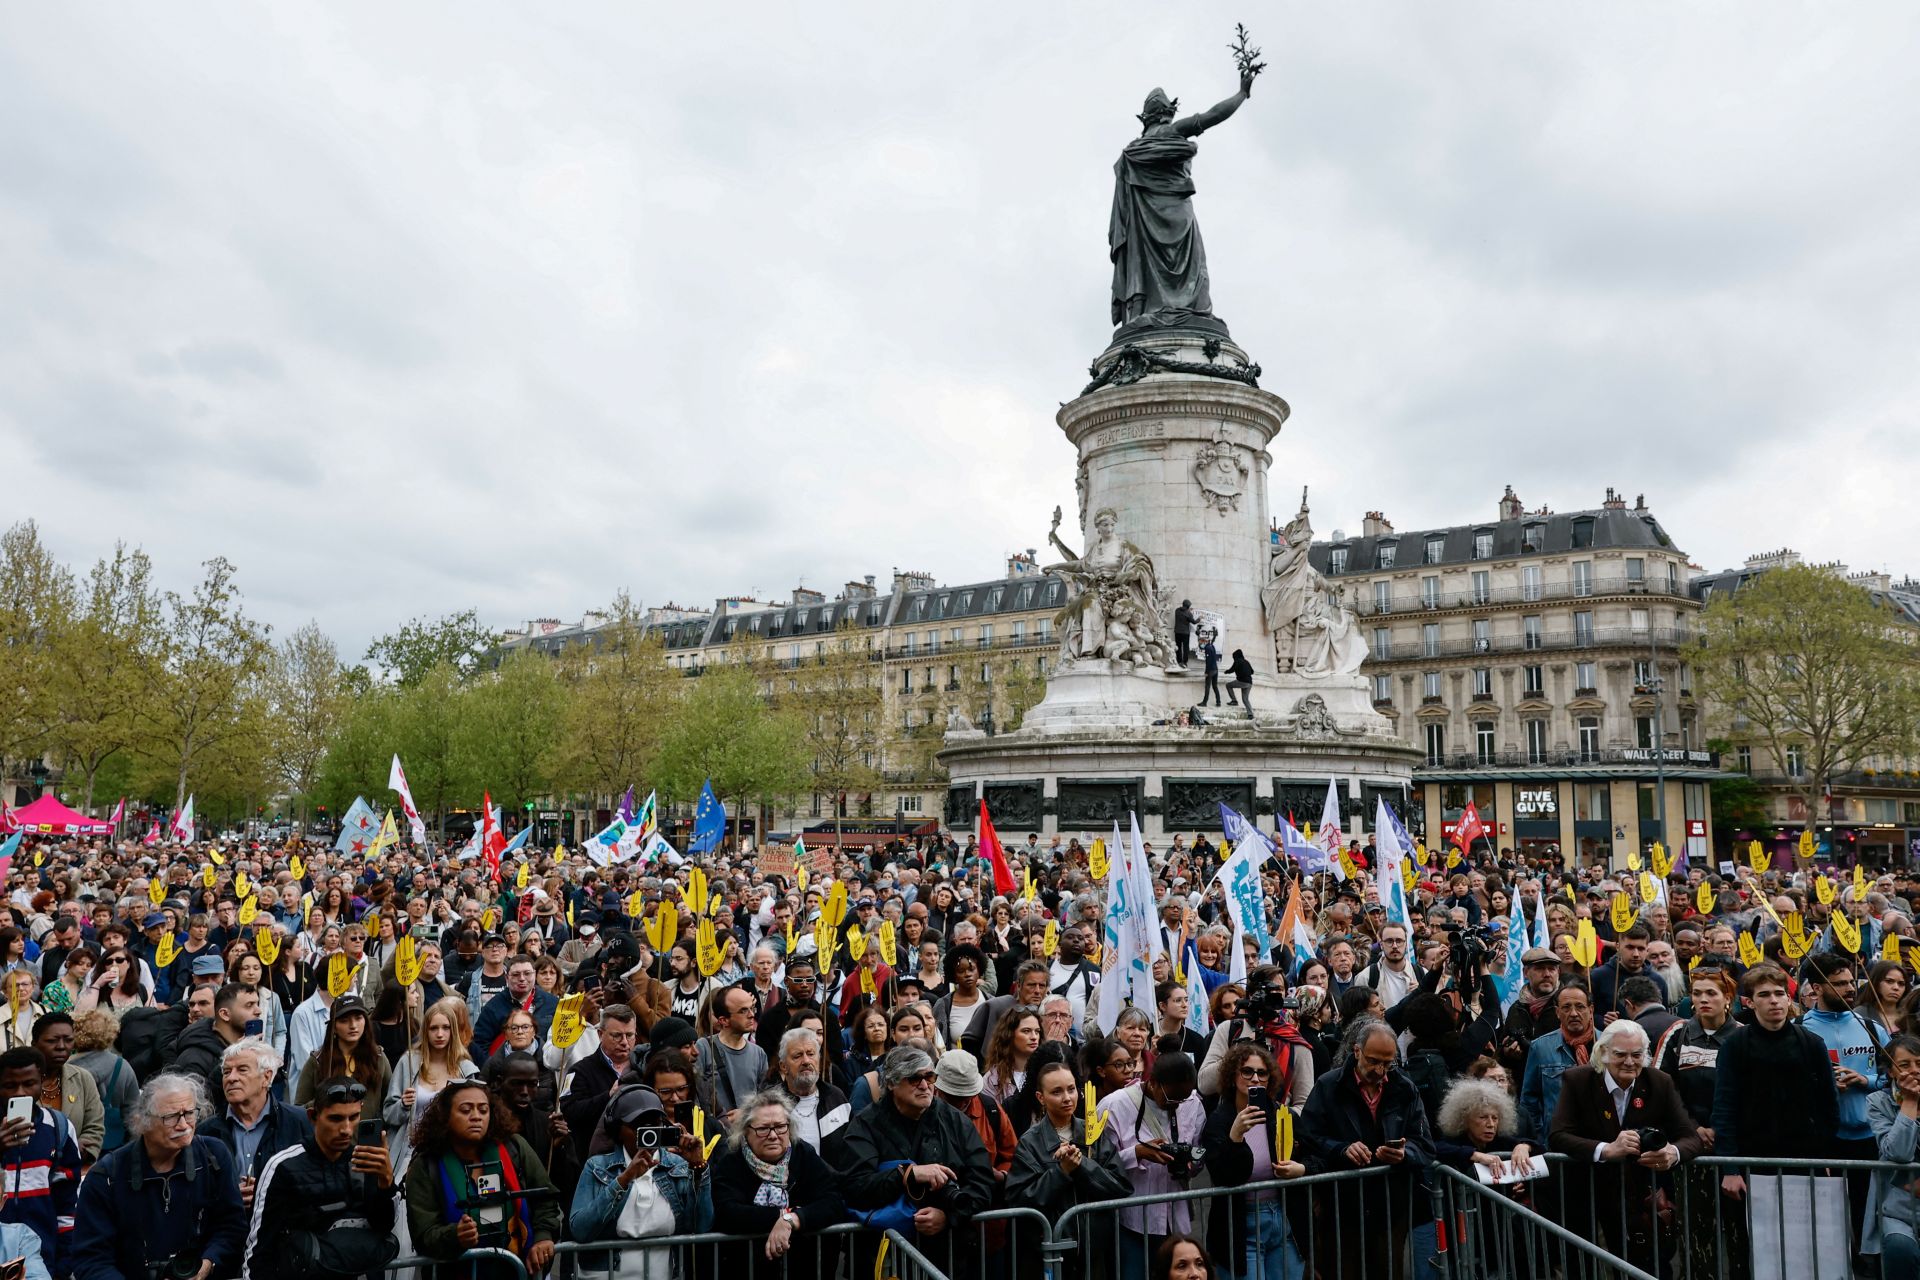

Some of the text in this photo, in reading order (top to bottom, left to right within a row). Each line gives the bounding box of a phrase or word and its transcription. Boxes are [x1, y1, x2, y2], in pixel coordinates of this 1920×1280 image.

[1624, 750, 1649, 760] WALL
[1652, 751, 1684, 760] SREET
[1520, 792, 1552, 802] FIVE
[1516, 802, 1556, 812] GUYS
